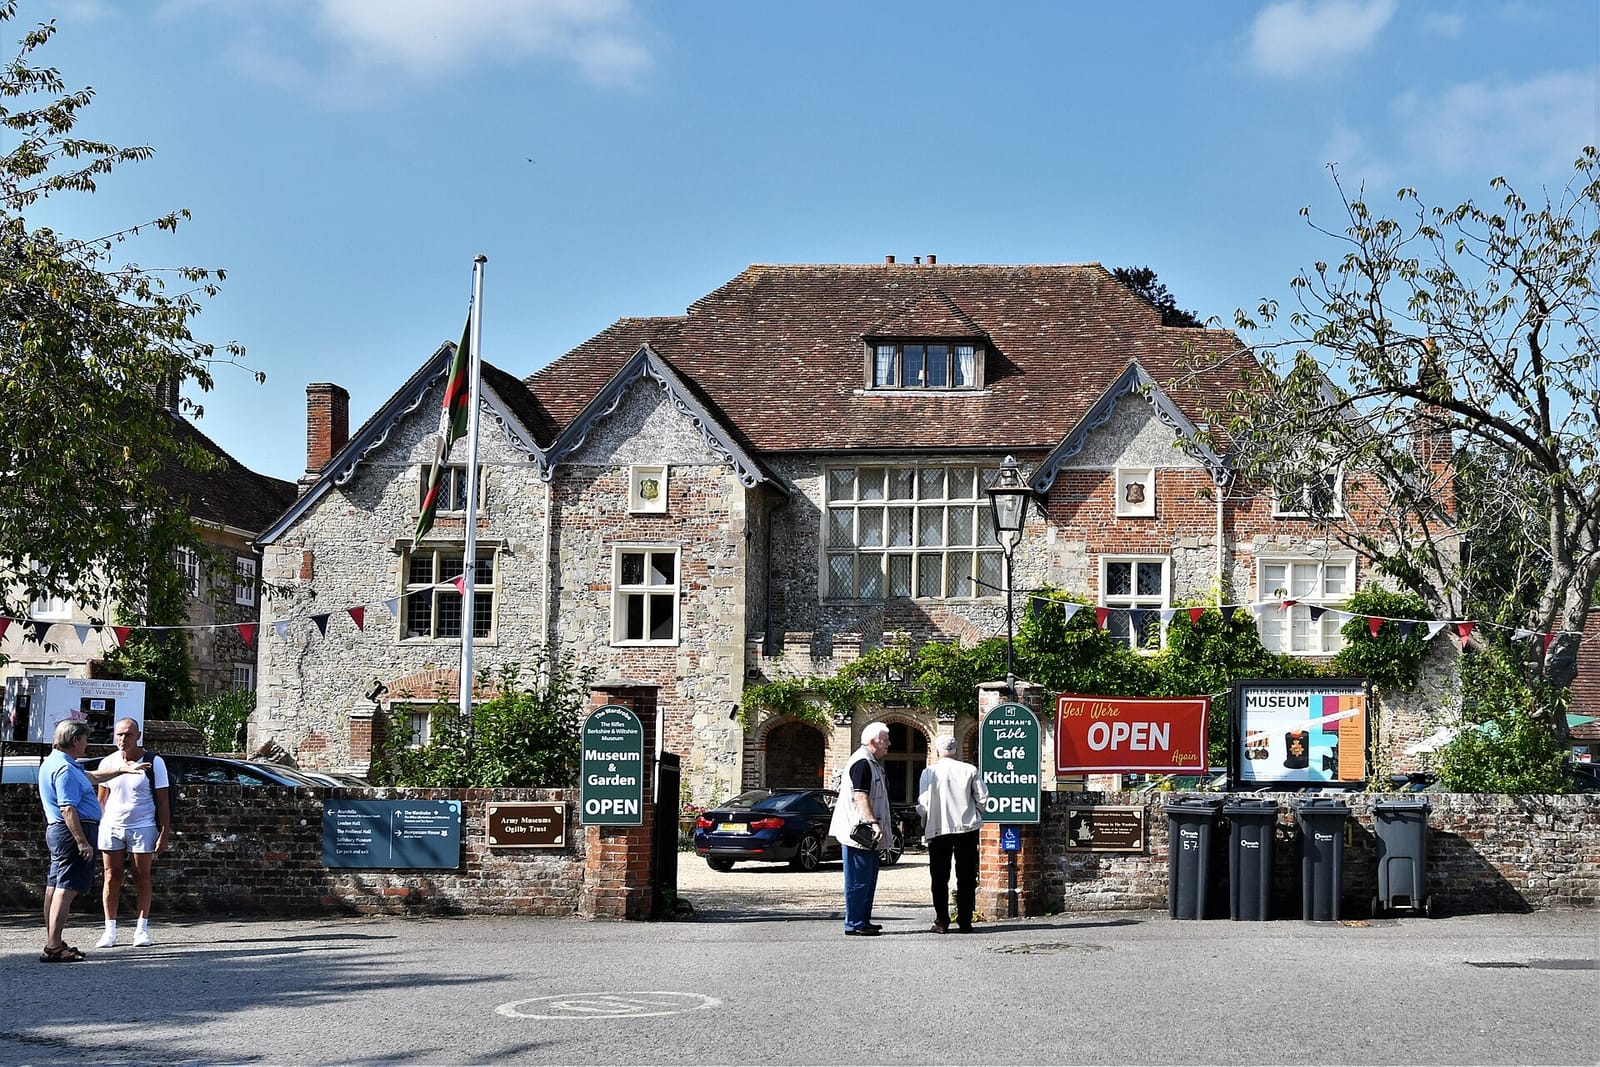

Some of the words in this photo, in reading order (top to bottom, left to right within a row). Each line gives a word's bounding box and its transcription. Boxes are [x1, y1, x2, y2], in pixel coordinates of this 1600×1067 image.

[1246, 696, 1309, 707] MUSEUM
[1063, 702, 1085, 719] Yes!
[1090, 702, 1120, 719] We're
[993, 727, 1027, 741] Table
[1087, 721, 1170, 751] OPEN
[585, 750, 640, 760] Museum
[994, 746, 1025, 759] Café
[1171, 749, 1198, 766] Again
[608, 763, 616, 772] &
[1006, 762, 1014, 770] &
[588, 774, 635, 785] Garden
[983, 771, 1036, 784] Kitchen
[585, 799, 638, 815] OPEN
[985, 797, 1035, 813] OPEN
[1184, 841, 1198, 851] 57
